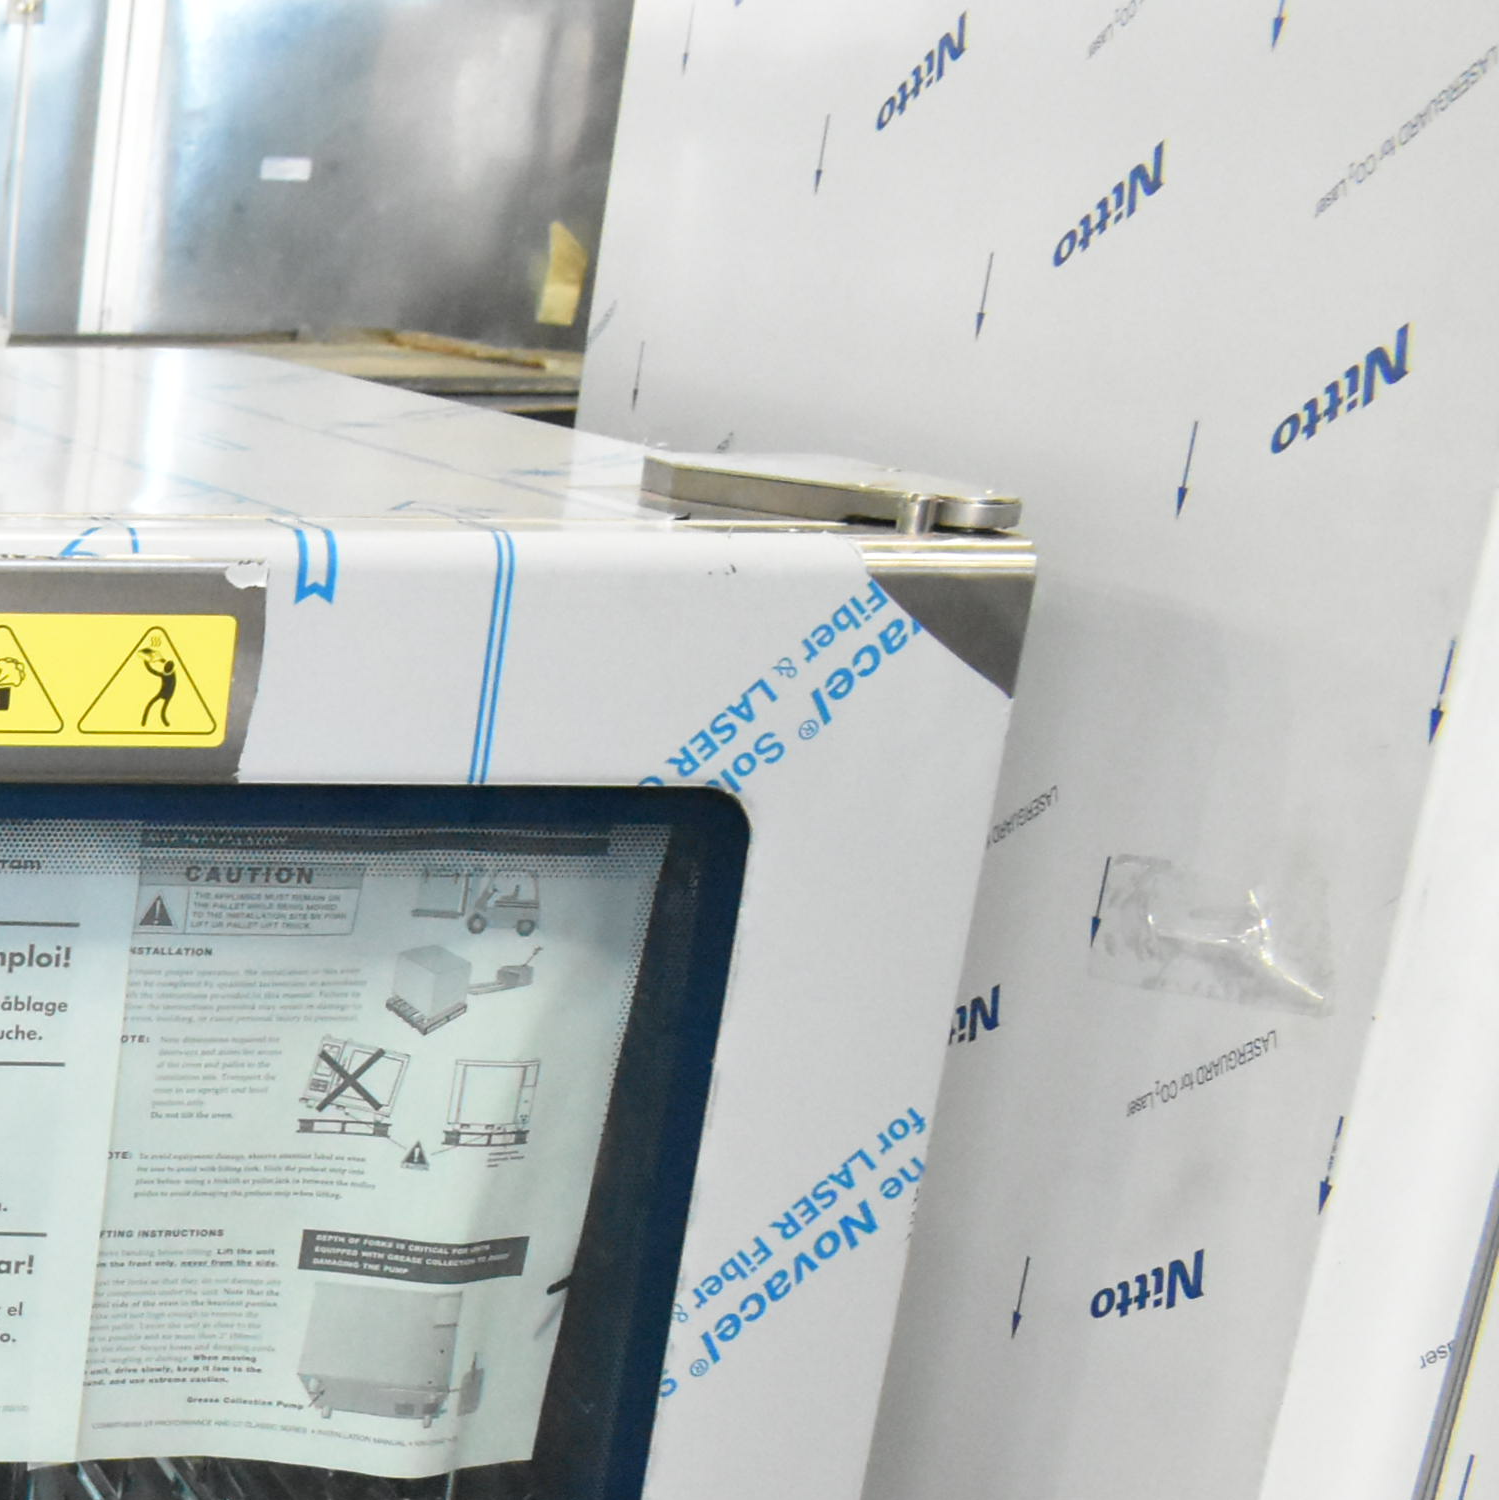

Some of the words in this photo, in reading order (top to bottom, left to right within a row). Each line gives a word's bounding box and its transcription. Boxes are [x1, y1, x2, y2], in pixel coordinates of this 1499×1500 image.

[875, 11, 968, 132] Nitto
[1053, 141, 1166, 267] Nitto
[1271, 322, 1411, 455] Nitto
[803, 581, 888, 662] Fiber
[773, 658, 798, 679] &
[665, 680, 777, 779] LASER
[185, 865, 314, 884] CAUTION
[1196, 1030, 1277, 1085] LASERGUARD
[877, 1107, 927, 1154] for
[769, 1149, 877, 1240] LASER
[137, 1228, 224, 1238] INSTRUCTIONS
[693, 1236, 773, 1309] Fiber
[1090, 1248, 1205, 1319] Nitto
[6, 1301, 24, 1317] el
